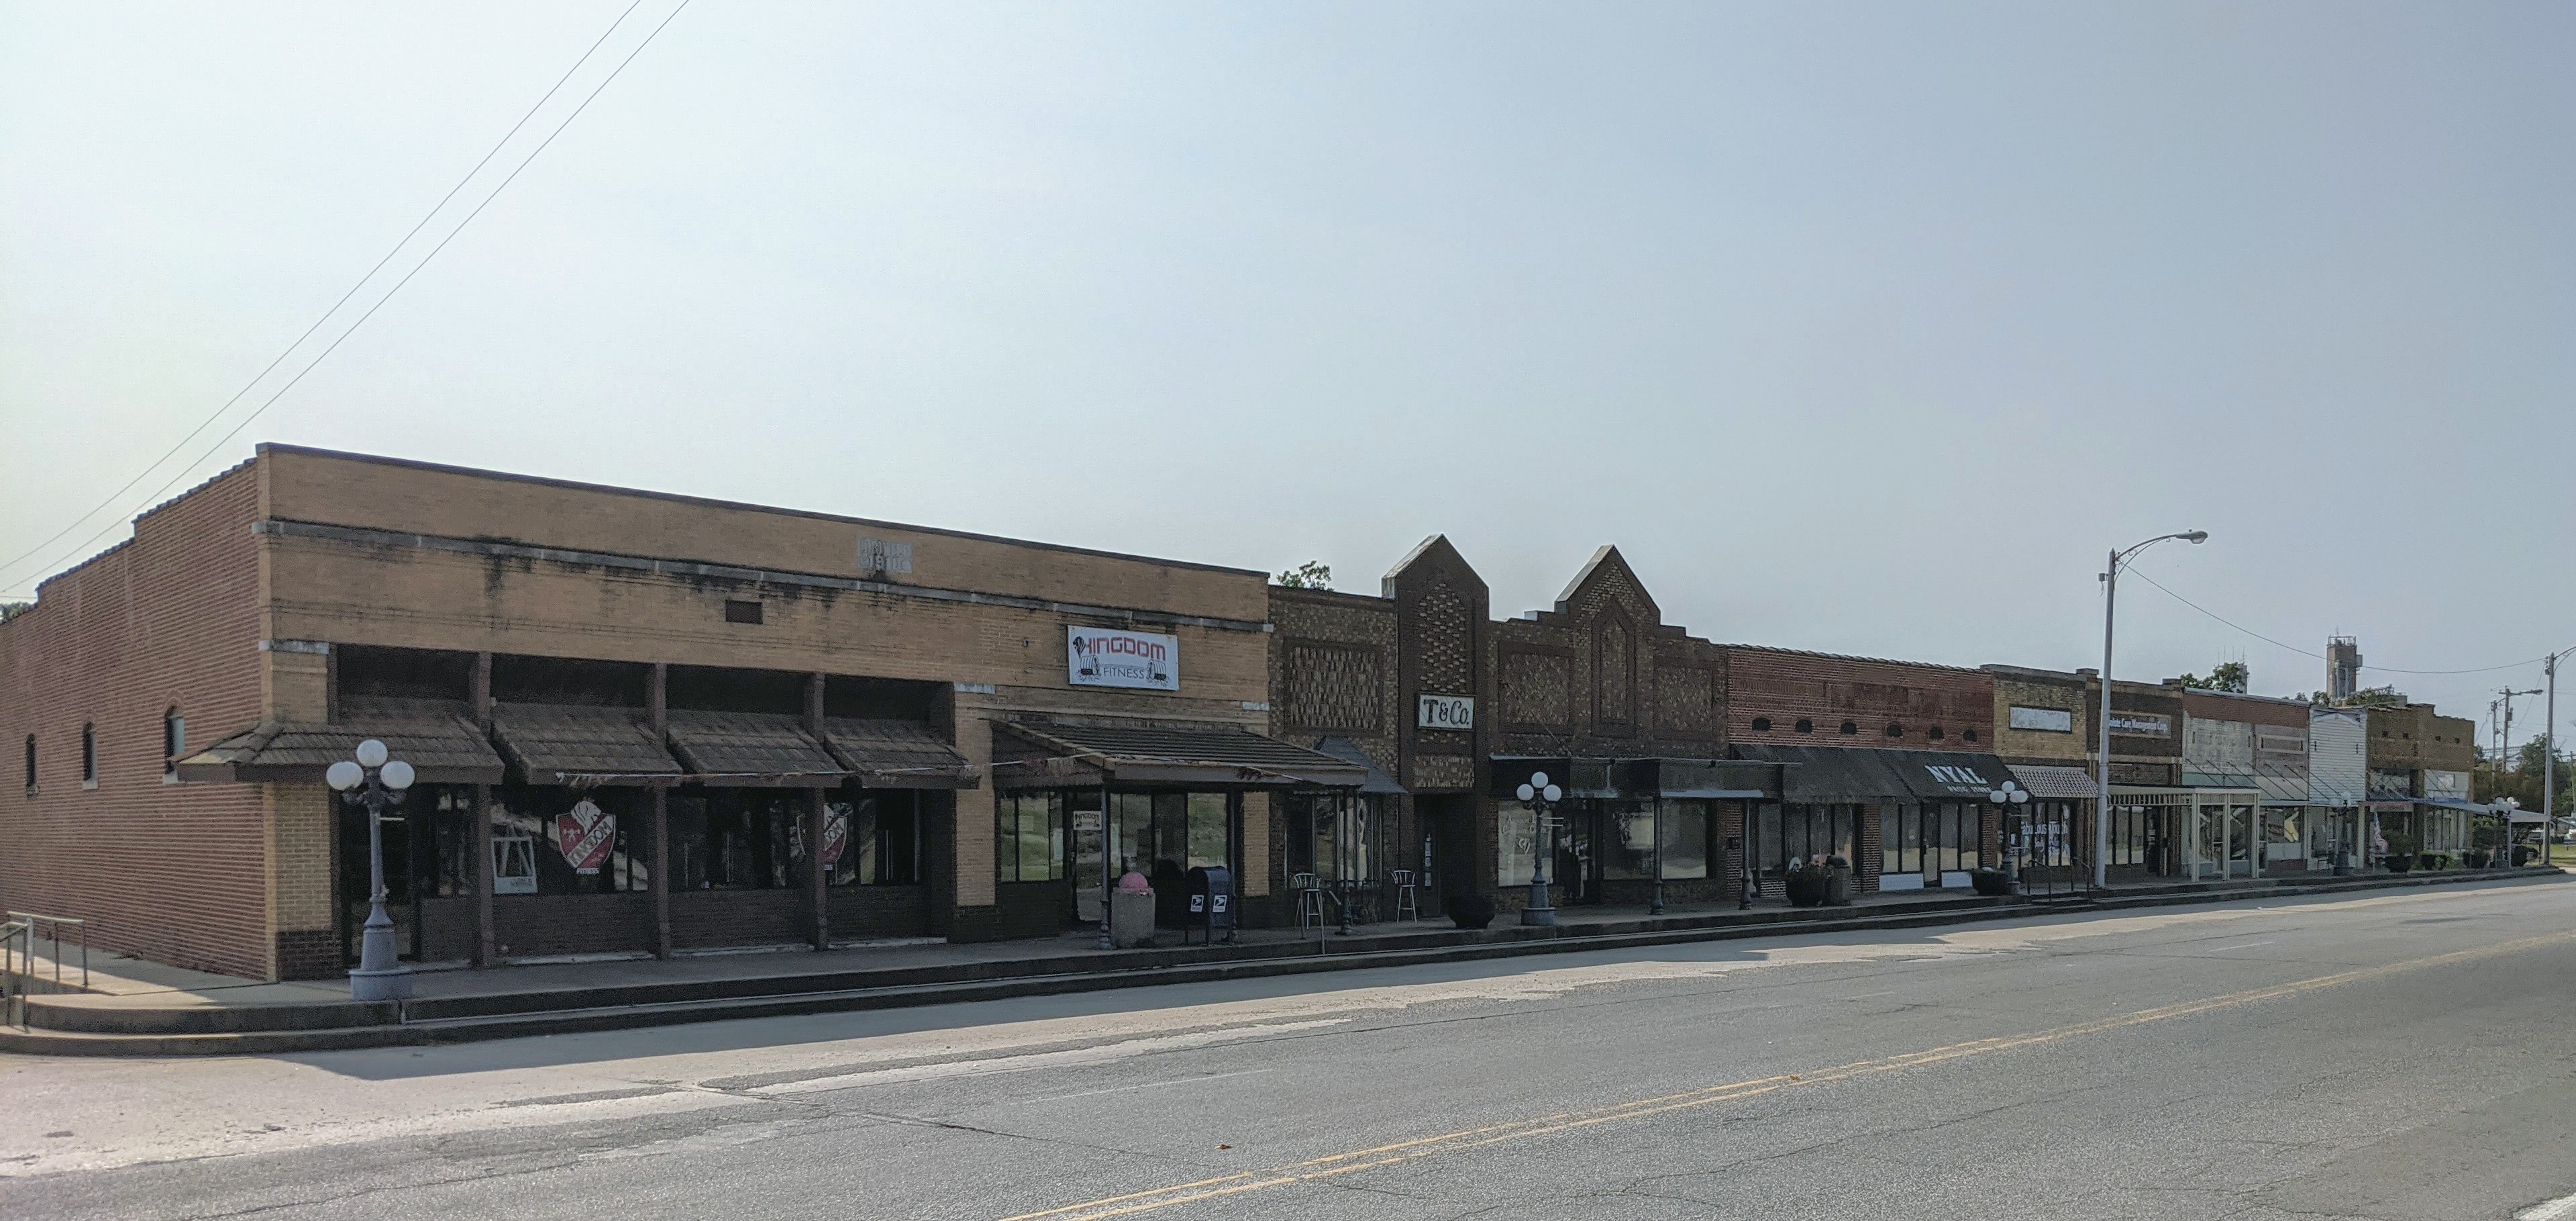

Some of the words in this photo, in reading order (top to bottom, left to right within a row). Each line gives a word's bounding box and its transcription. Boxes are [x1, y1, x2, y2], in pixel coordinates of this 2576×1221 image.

[1103, 666, 1144, 679] FITNESS
[1423, 699, 1439, 723] T
[1439, 702, 1449, 722] &
[1450, 700, 1469, 725] Co.
[2121, 718, 2131, 728] Care
[1924, 765, 1988, 784] NYAL
[568, 820, 613, 866] KINGDOM
